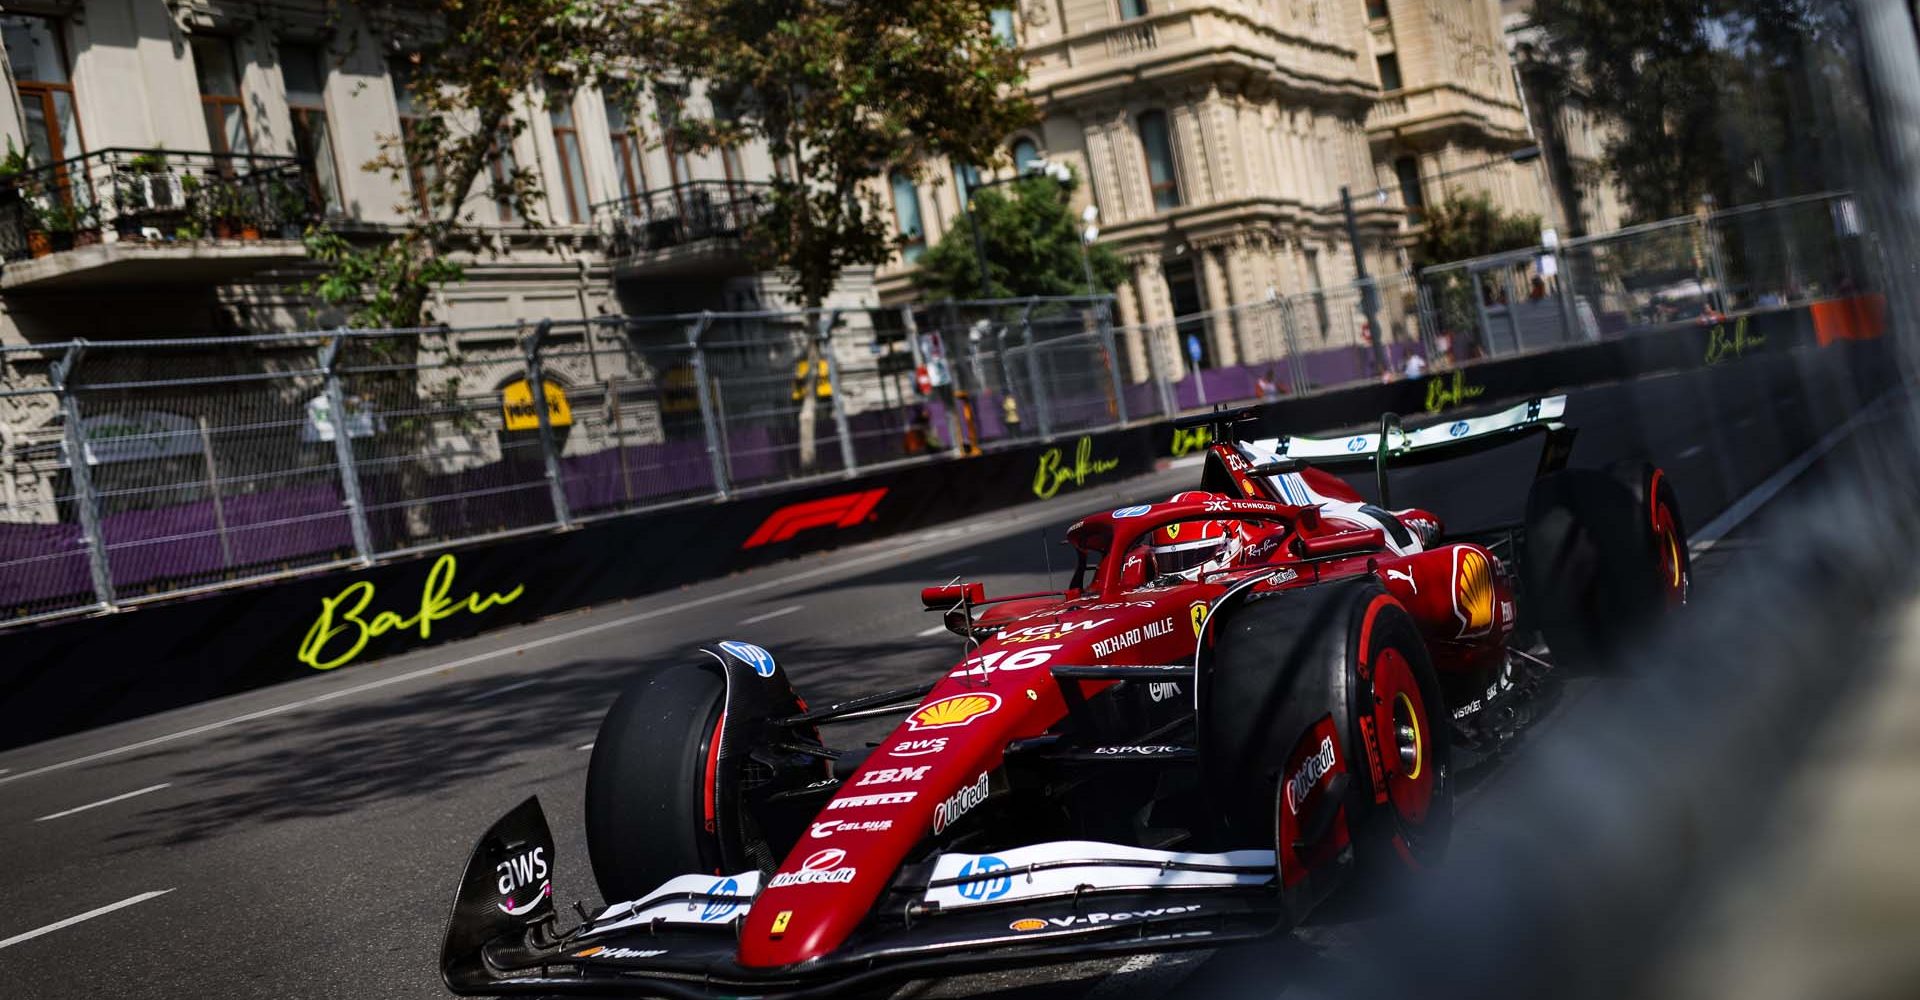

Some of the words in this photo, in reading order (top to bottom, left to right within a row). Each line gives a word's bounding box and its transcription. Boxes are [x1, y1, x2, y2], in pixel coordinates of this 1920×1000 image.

[1425, 369, 1485, 413] Baku
[1171, 426, 1212, 457] Bak
[1450, 420, 1468, 436] hp
[1349, 437, 1366, 451] hp
[1032, 435, 1119, 499] Baku
[1204, 500, 1231, 511] DXC
[1232, 502, 1277, 511] TECHNOLOGY
[298, 554, 524, 670] Baku
[997, 618, 1115, 640] VGW
[1000, 630, 1073, 646] PLAY
[1091, 628, 1141, 659] RICHARD
[1143, 617, 1174, 641] MILLE
[721, 641, 775, 677] hp
[949, 644, 1064, 678] 16
[895, 737, 949, 752] aws
[855, 765, 932, 787] IBM
[827, 791, 918, 810] PIRELLI
[945, 770, 989, 824] UniCredit
[836, 820, 893, 830] CELSIUS
[496, 847, 548, 895] aws
[767, 867, 856, 888] UniCredit
[961, 857, 1009, 900] hp
[702, 879, 737, 921] hp
[1049, 903, 1201, 927] V-Power
